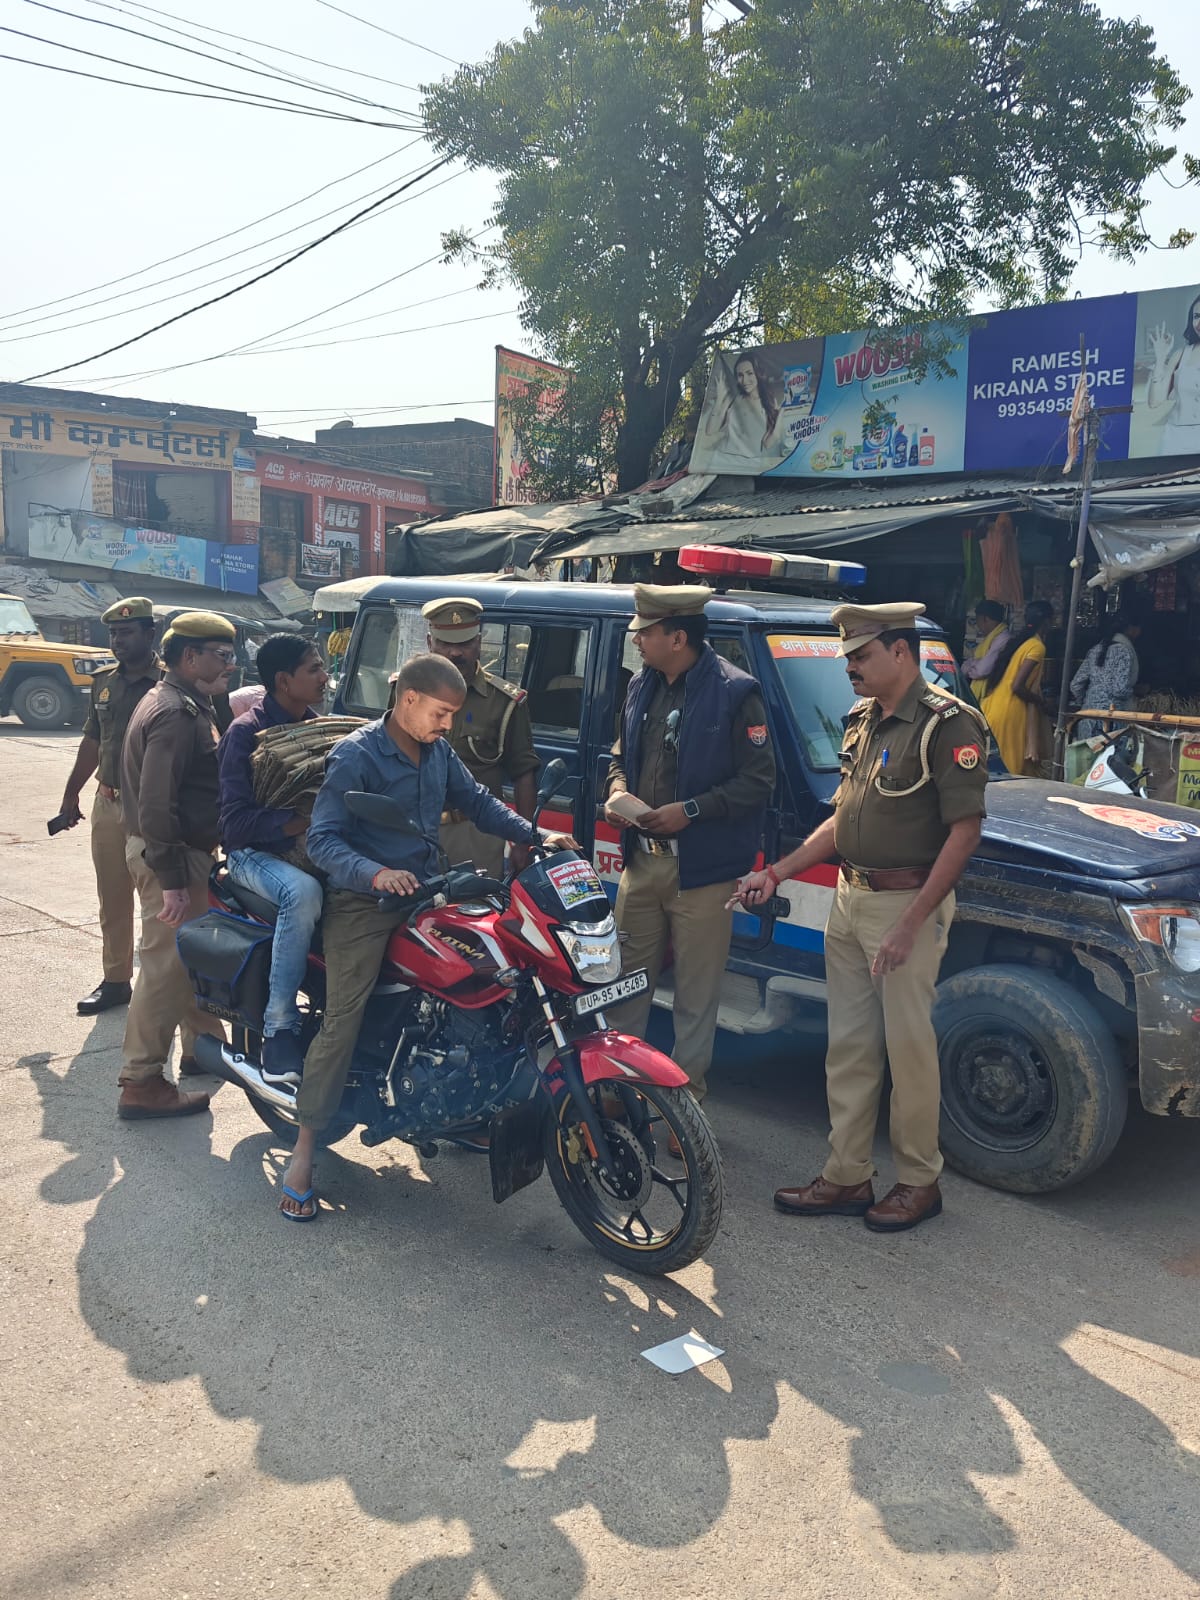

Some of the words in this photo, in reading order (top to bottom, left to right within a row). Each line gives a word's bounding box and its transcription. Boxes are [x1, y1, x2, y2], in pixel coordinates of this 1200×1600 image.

[1011, 348, 1100, 374] RAMESH
[871, 376, 899, 390] WASHING
[973, 378, 1048, 400] KIRANA
[1053, 368, 1126, 392] STORE
[997, 394, 1096, 418] 993549584
[790, 416, 815, 433] WOOSH
[793, 424, 820, 441] KHOOSH
[264, 462, 285, 475] ACC
[324, 503, 360, 529] ACC
[426, 927, 487, 960] PLATINA
[586, 993, 599, 1008] UP
[601, 987, 614, 1002] 95
